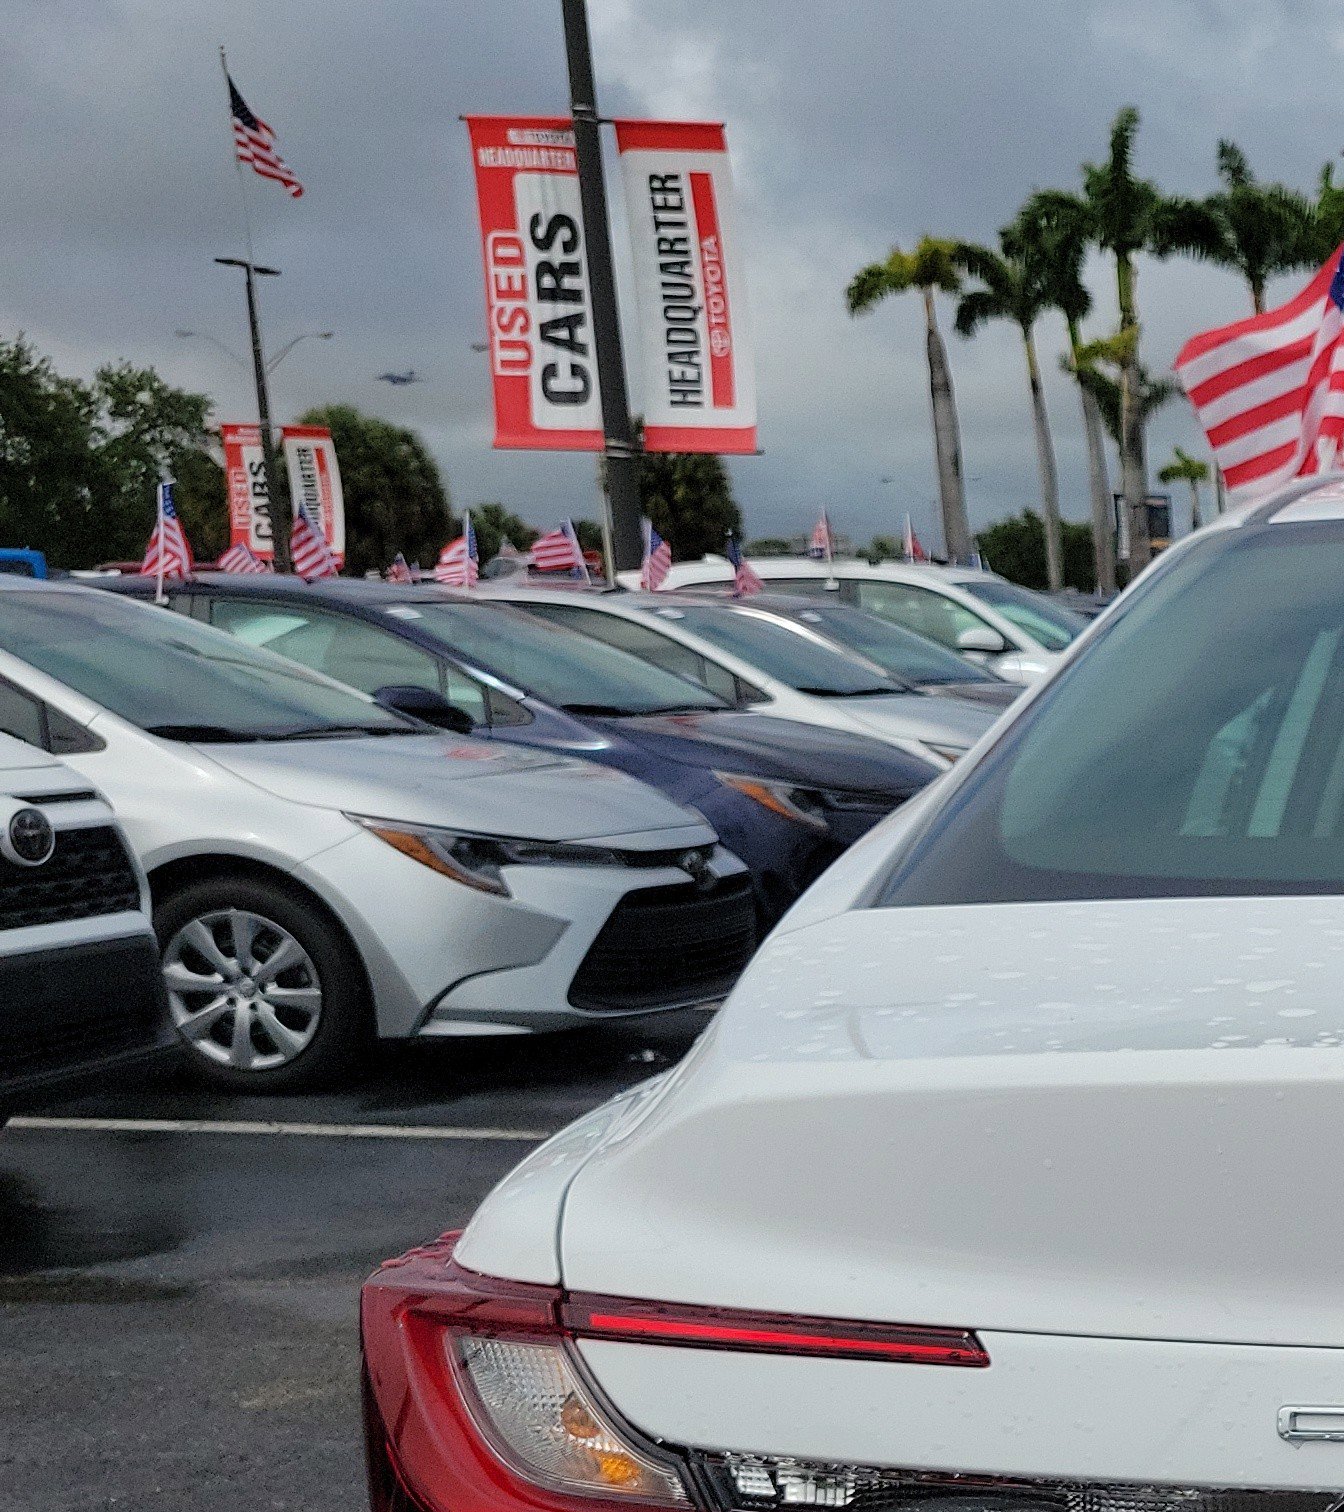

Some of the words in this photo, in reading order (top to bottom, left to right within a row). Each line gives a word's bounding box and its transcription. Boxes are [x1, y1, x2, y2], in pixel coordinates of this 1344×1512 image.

[491, 234, 533, 374] USED
[530, 211, 592, 407] CARS
[649, 172, 705, 409] HEADQUARTER
[702, 234, 731, 332] TOYOTA
